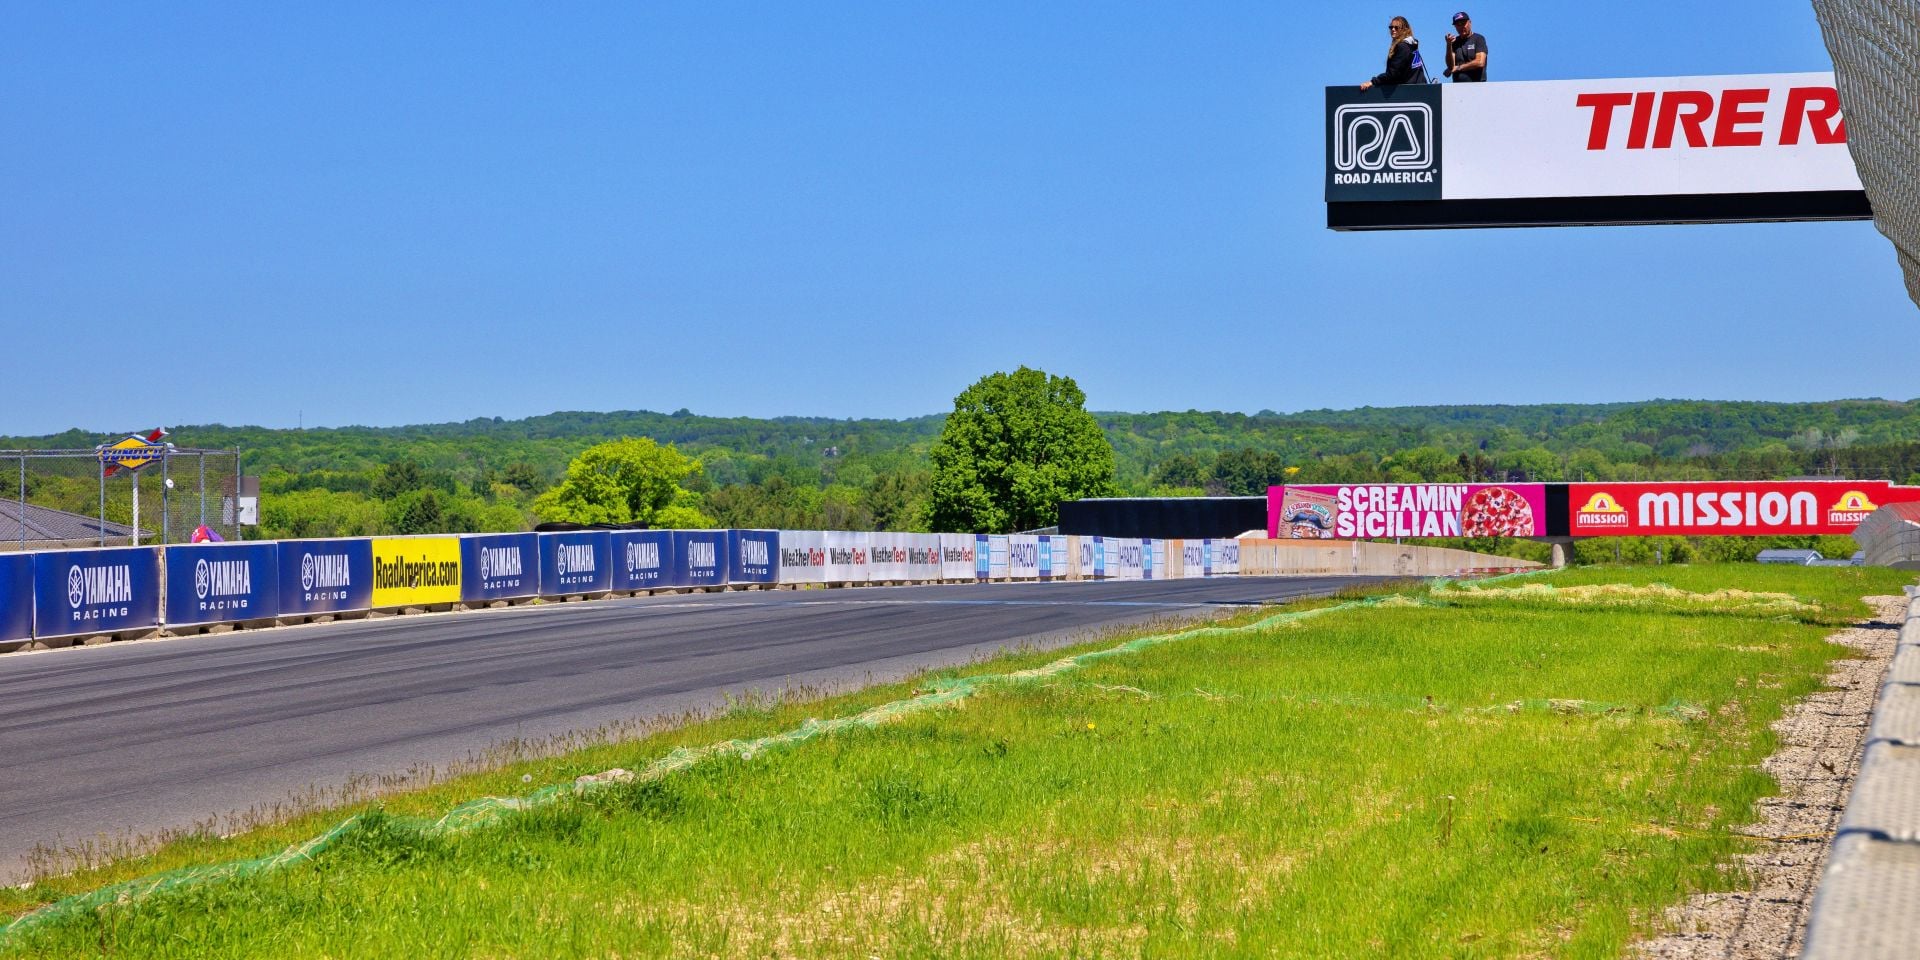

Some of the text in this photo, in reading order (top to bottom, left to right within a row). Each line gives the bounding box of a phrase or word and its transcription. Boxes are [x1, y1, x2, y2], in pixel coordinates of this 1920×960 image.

[1576, 88, 1770, 150] TIRE
[1334, 171, 1433, 185] ROAD AMERICA
[1337, 485, 1468, 513] SCREAMIN'
[1638, 491, 1818, 527] MISSION
[1337, 511, 1461, 537] SICILIAN
[1579, 513, 1626, 525] MISSION
[489, 546, 522, 577] YAMAHA
[566, 544, 595, 573] YAMAHA
[781, 547, 825, 567] WeatherTech
[829, 547, 866, 565] WeatherTech
[871, 546, 907, 564] WeatherTech
[209, 560, 251, 596] YAMAHA
[313, 554, 350, 587] YAMAHA
[375, 554, 458, 589] RoadAmerica.com
[560, 574, 594, 585] RACING
[83, 565, 132, 604] YAMAHA
[305, 590, 347, 602] RACING
[483, 579, 520, 590] RACING
[73, 607, 129, 621] RACING
[200, 599, 248, 611] RACING
